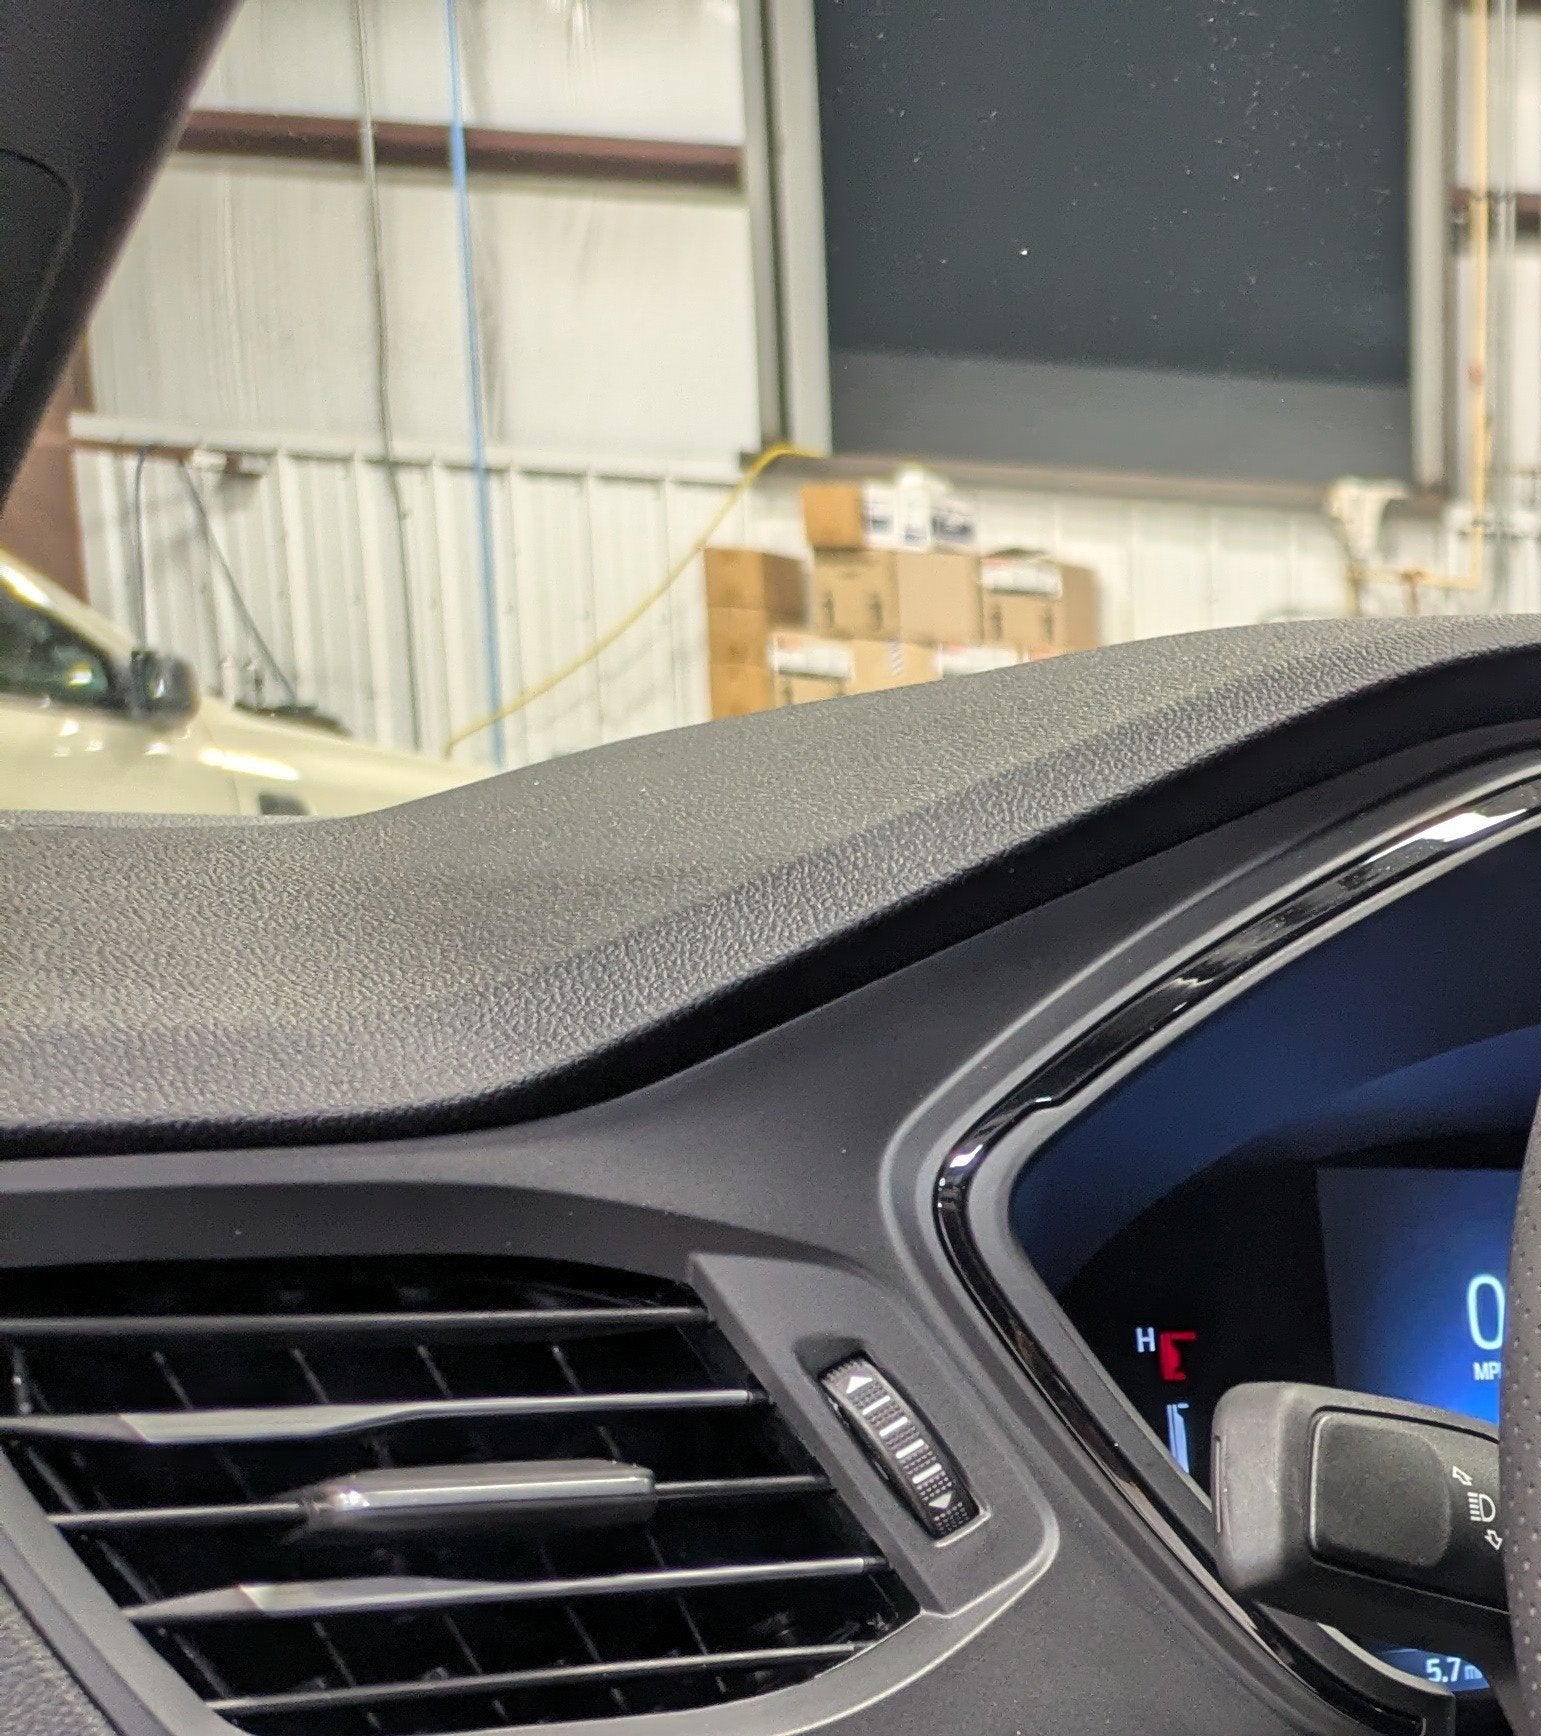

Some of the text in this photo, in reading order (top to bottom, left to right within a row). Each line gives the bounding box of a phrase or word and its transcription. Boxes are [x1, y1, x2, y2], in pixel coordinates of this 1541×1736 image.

[1467, 1274, 1506, 1350] 0
[1135, 1326, 1156, 1353] H
[1472, 1361, 1502, 1380] MP
[1426, 1656, 1461, 1682] 5.7
